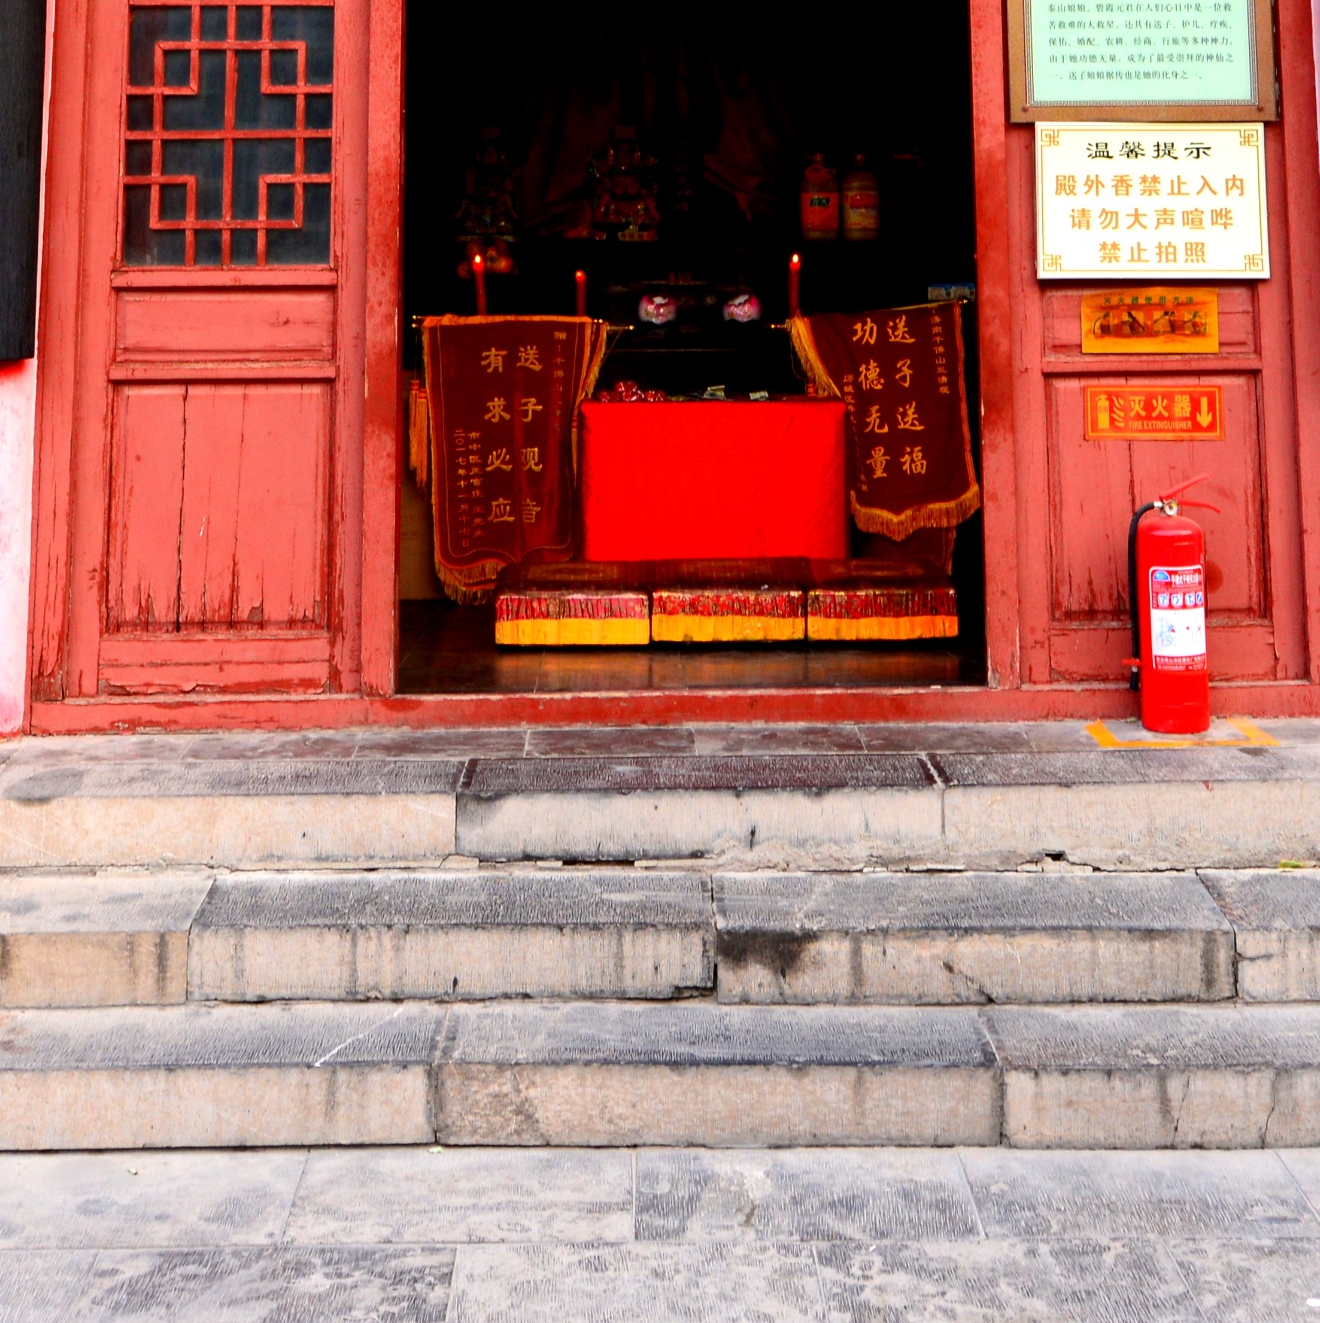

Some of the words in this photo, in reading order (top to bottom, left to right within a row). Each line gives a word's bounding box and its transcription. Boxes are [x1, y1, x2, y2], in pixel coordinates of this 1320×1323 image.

[1086, 141, 1212, 160] 温馨提示
[1055, 174, 1245, 197] 殿外香禁止入内
[1069, 208, 1234, 230] 请勿大声喧哗
[1099, 241, 1207, 264] 禁止拍照
[1104, 295, 1195, 305] 灭火器使用方法
[852, 317, 891, 479] 功德无量
[886, 314, 927, 476] 送子送福
[1129, 394, 1192, 418] 灭火器
[481, 346, 516, 524] 有求必应
[516, 344, 543, 523] 送子观音
[1129, 420, 1143, 430] FIRE
[1144, 420, 1192, 430] EXTINGUISHER
